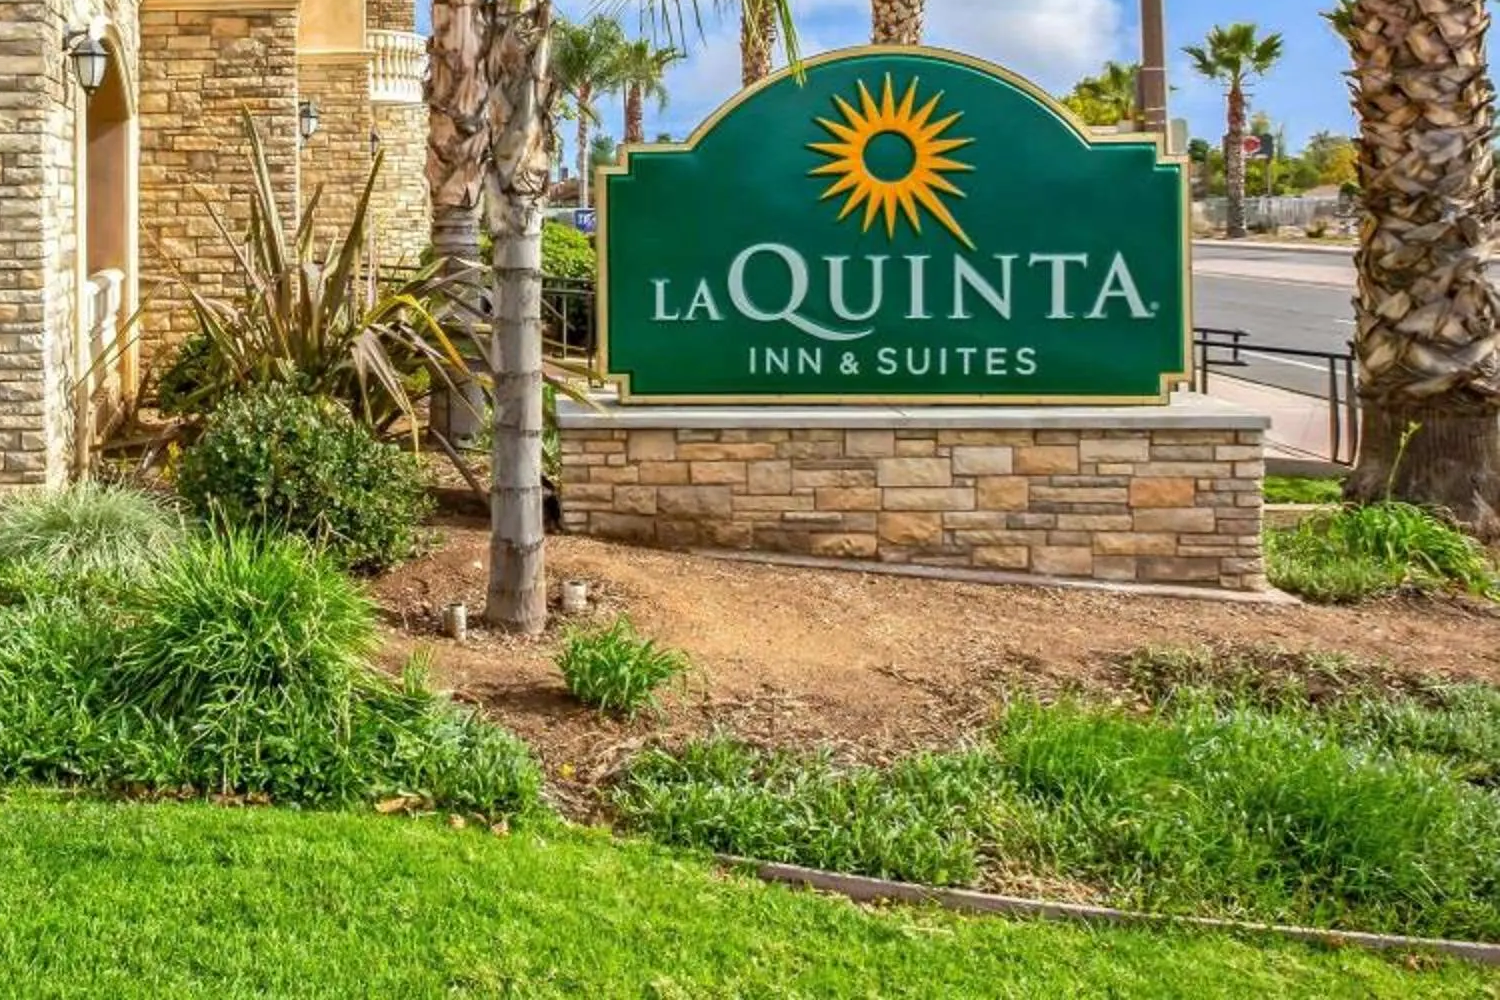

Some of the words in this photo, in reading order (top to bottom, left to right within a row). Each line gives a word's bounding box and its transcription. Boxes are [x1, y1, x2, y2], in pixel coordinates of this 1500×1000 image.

[650, 278, 724, 321] LA
[727, 242, 1153, 341] QUINTA
[749, 347, 822, 375] INN
[839, 350, 860, 375] &
[877, 347, 1038, 375] SUITES
